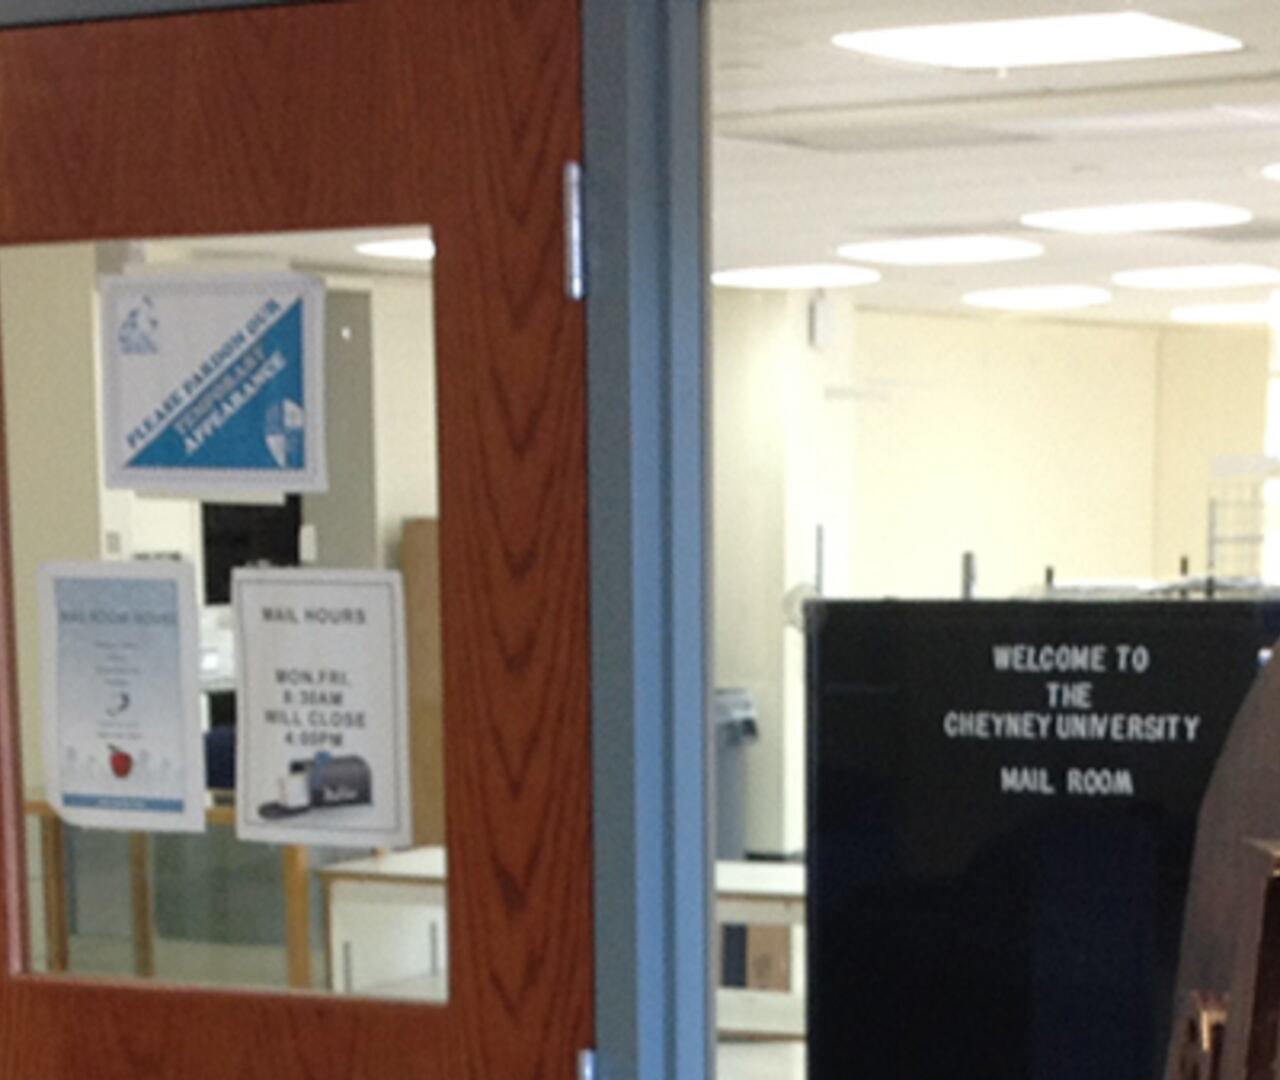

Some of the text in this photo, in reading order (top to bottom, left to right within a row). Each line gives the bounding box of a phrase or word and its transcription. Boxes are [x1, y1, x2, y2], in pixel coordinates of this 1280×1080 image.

[262, 608, 366, 625] MAIL HOURS
[992, 644, 1151, 673] WELCOME TO
[1045, 681, 1093, 708] THE
[264, 709, 367, 729] WILL CLOSE
[942, 710, 1201, 742] CHEYNEY UNIVERSITY
[1000, 766, 1135, 794] MAIL ROOM
